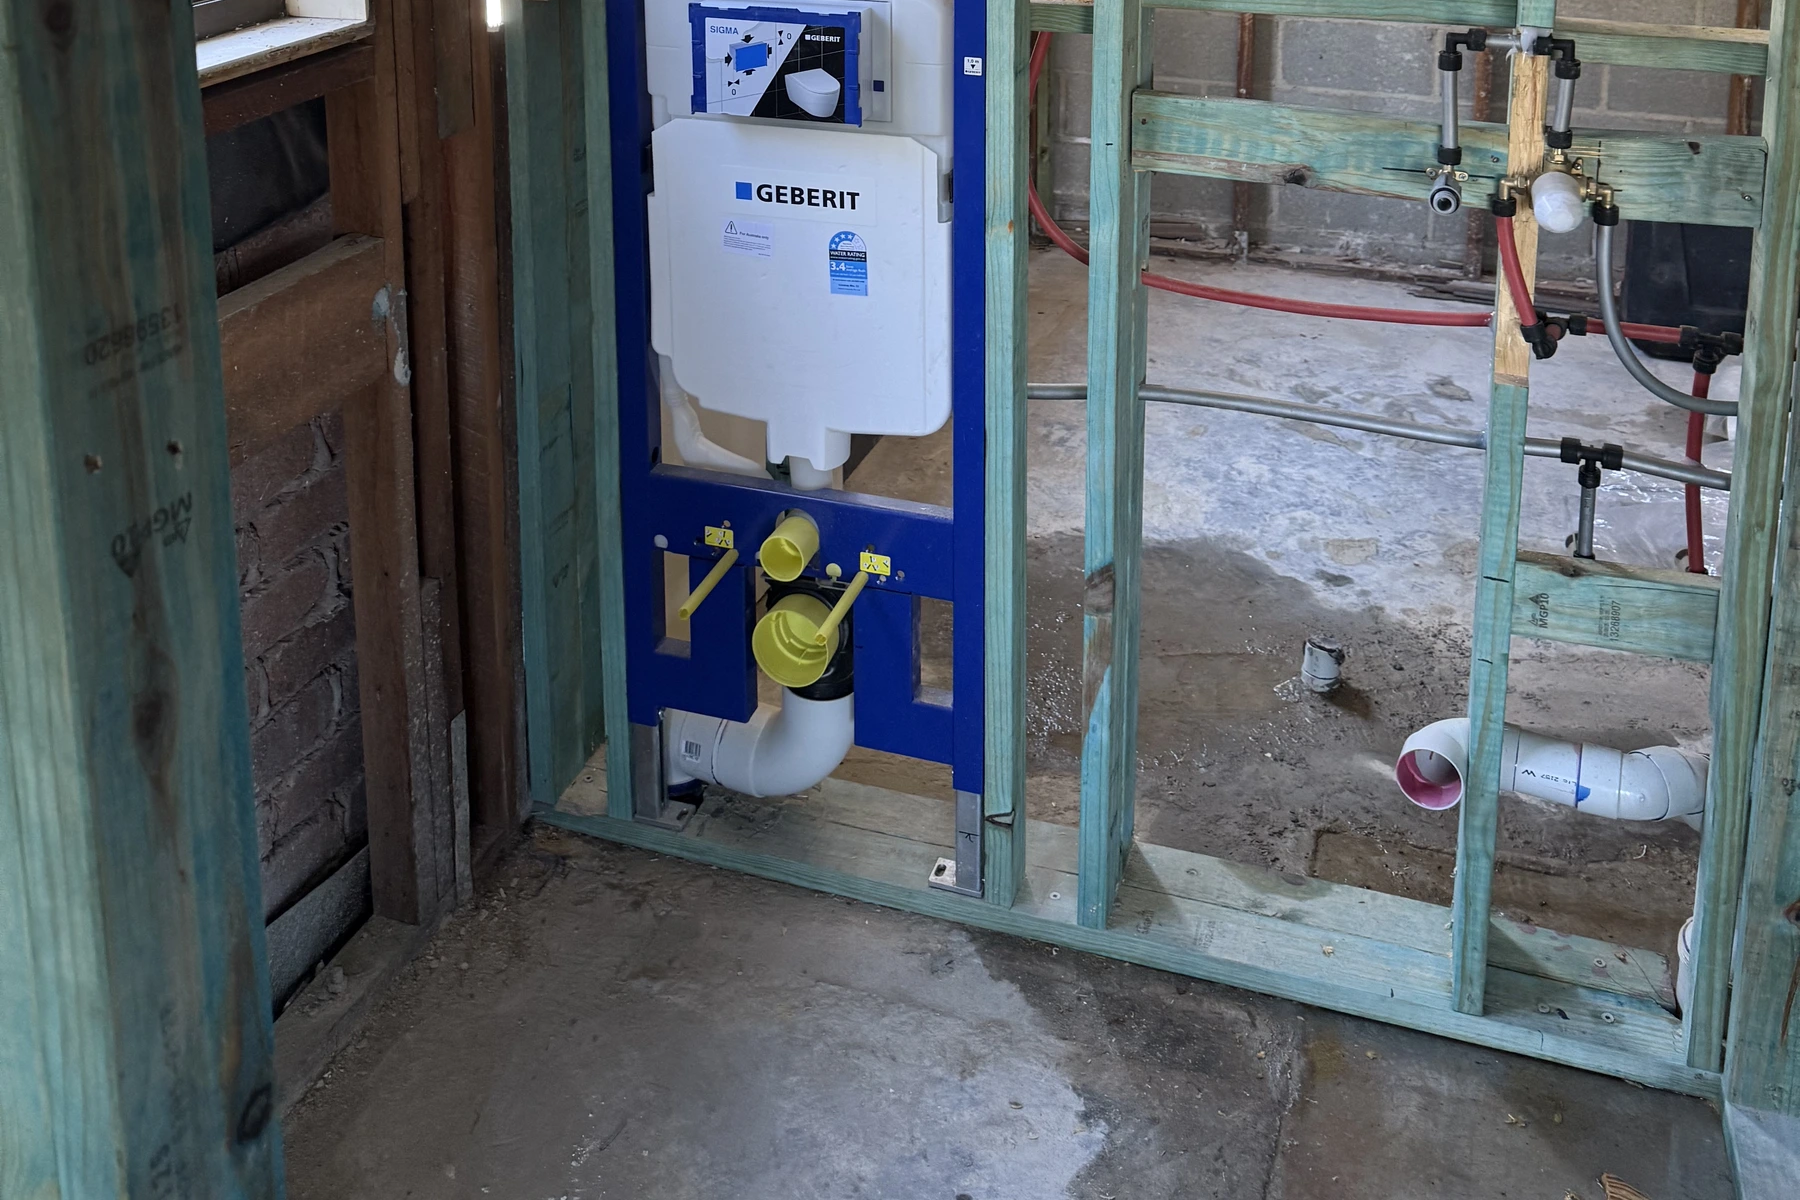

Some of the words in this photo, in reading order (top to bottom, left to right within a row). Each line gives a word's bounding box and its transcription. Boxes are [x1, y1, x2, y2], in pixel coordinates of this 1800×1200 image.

[710, 25, 739, 35] SIGMA
[811, 35, 841, 43] GEBERIT
[756, 184, 860, 210] GEBERIT
[830, 261, 846, 270] 3.4
[1538, 593, 1550, 628] MGP10
